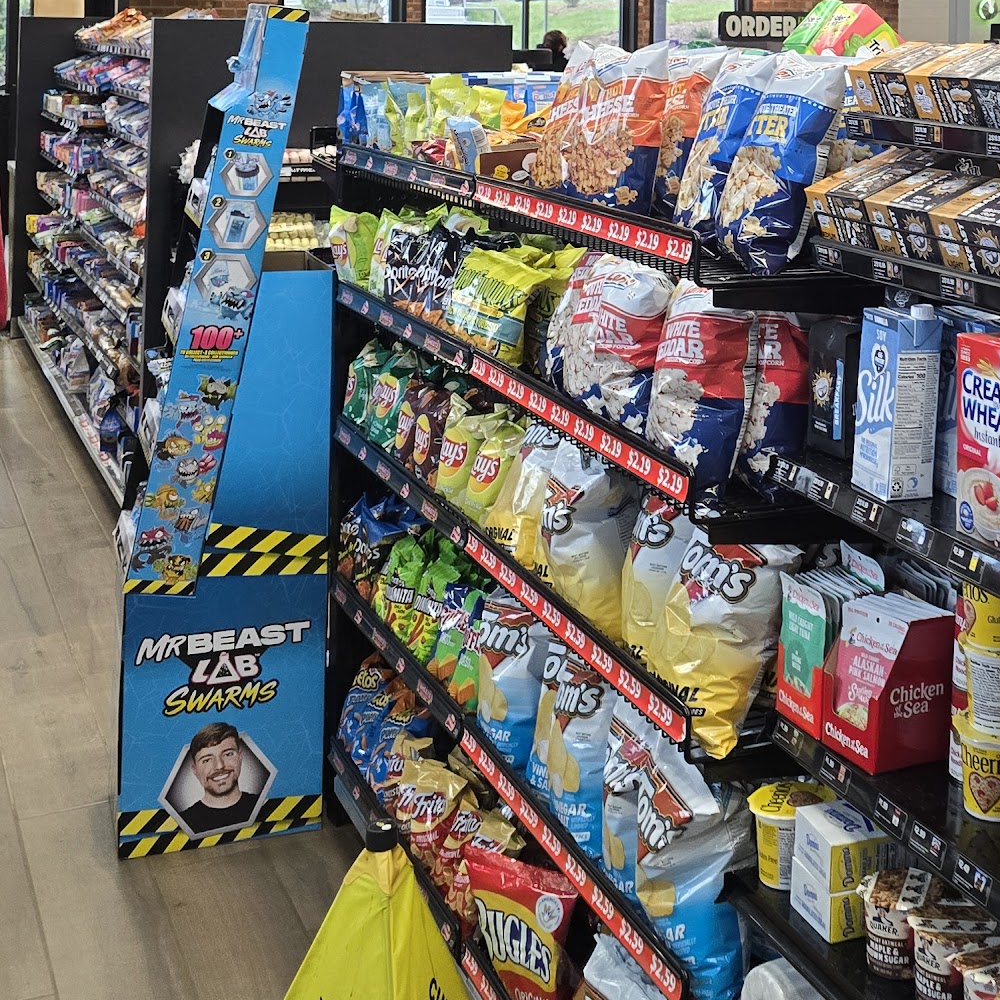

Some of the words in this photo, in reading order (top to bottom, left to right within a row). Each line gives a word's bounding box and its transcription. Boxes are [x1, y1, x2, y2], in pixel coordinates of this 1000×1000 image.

[725, 15, 797, 38] ORDER
[771, 104, 798, 117] THEATER
[476, 184, 491, 198] $2.19
[514, 196, 531, 212] $2.19
[557, 207, 577, 226] $2.19
[607, 222, 629, 242] $2.19
[666, 241, 692, 261] $2.19
[191, 326, 243, 350] 100+
[666, 321, 701, 338] WHITE
[876, 328, 886, 341] SOY
[657, 338, 704, 361] EDDAR
[488, 368, 504, 388] $2.19
[529, 391, 547, 413] $2.19
[834, 375, 842, 426] BREAKFAST
[856, 369, 895, 427] Silk
[627, 451, 651, 475] $2.19
[657, 470, 683, 494] $2.19
[480, 548, 496, 569] $2.59
[520, 583, 538, 606] $2.59
[565, 621, 585, 648] $2.59
[856, 631, 880, 650] Chicken
[884, 644, 898, 656] Sea
[192, 651, 259, 685] LAB
[852, 655, 885, 676] ALASKAN
[617, 668, 642, 699] $2.59
[862, 671, 886, 689] SALMON
[164, 679, 278, 717] SWARMS
[889, 682, 945, 706] Chicken
[648, 696, 673, 726] $2.59
[779, 689, 801, 713] Chicken
[802, 706, 814, 724] Sea
[903, 701, 929, 719] Sea
[825, 722, 850, 748] Chicken
[854, 739, 869, 759] Sea
[478, 751, 495, 776] $2.59
[519, 799, 538, 828] $2.59
[619, 921, 644, 955] $2.59
[870, 922, 899, 936] QUAKER
[870, 941, 892, 955] MAPLE
[884, 954, 909, 965] SUGAR
[650, 953, 676, 992] $2.59
